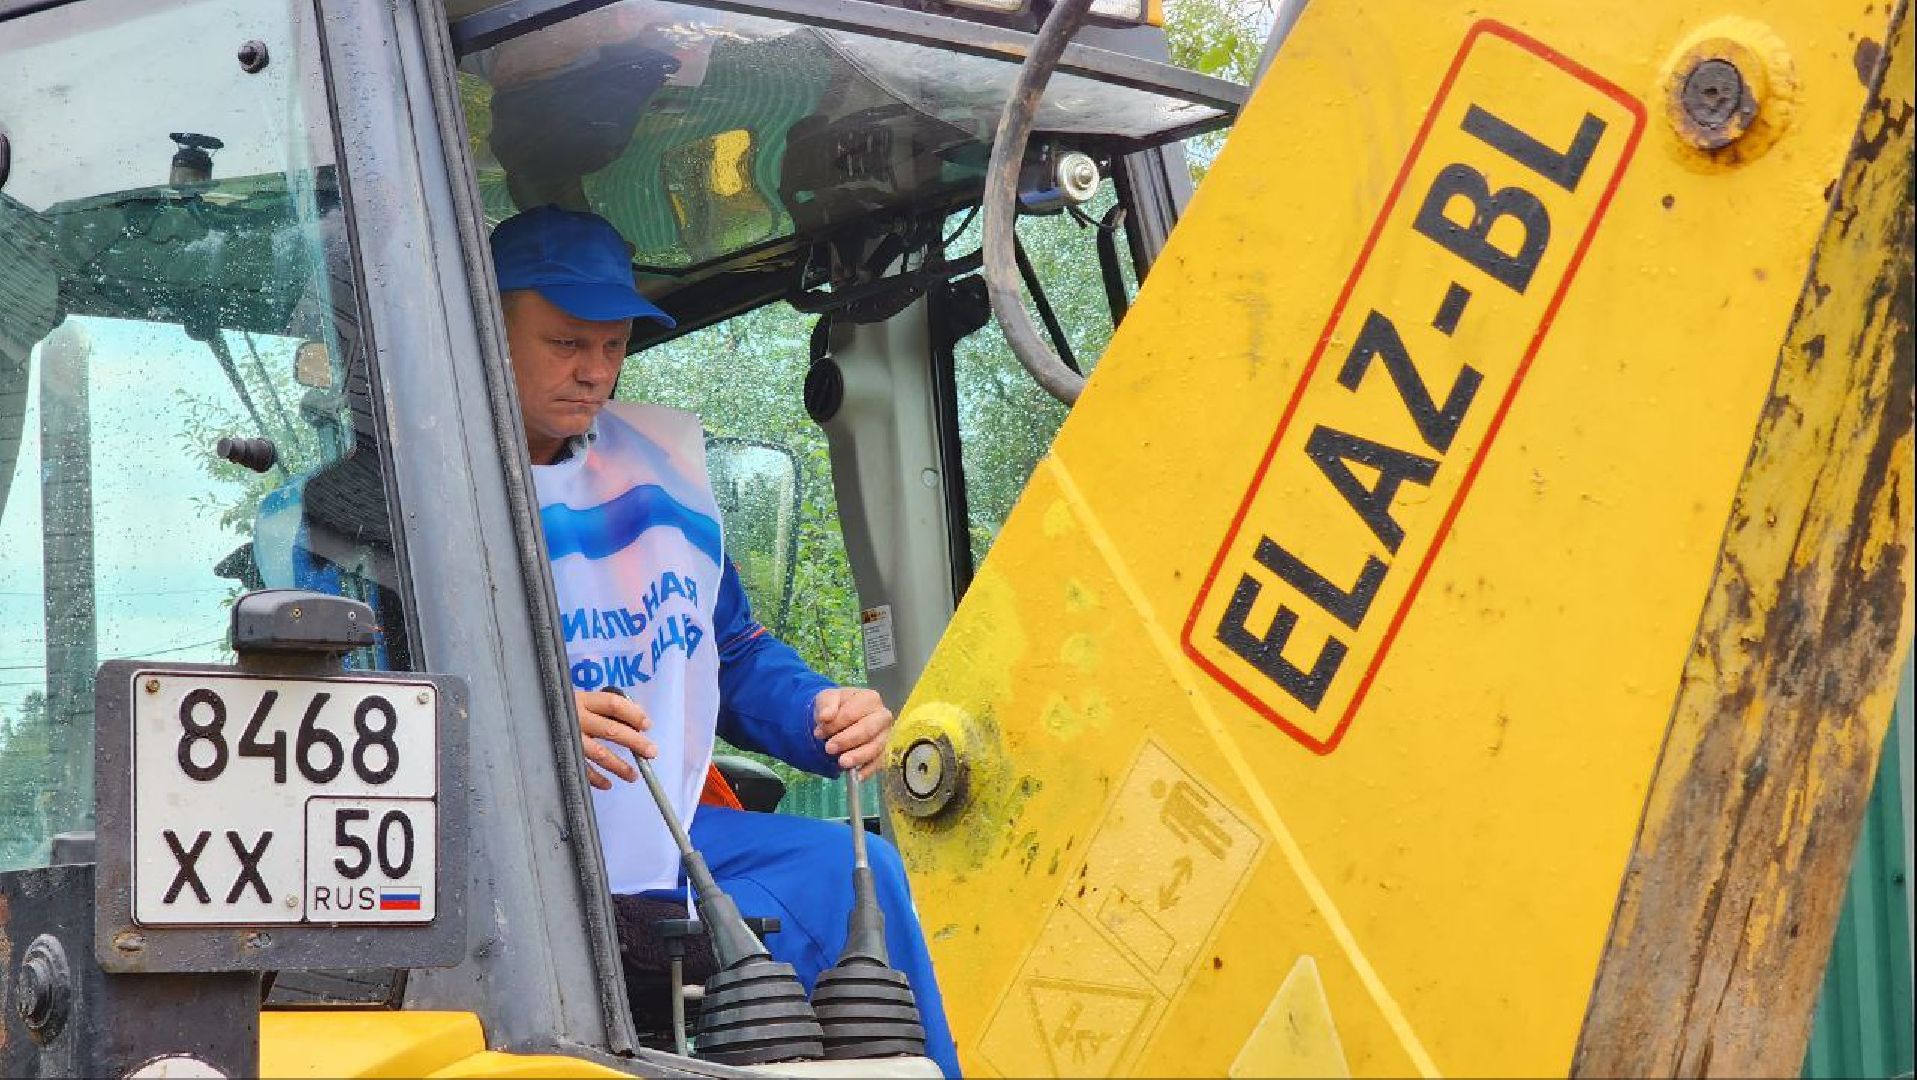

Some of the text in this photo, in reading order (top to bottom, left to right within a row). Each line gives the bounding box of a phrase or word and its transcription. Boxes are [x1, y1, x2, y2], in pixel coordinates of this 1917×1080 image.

[1216, 103, 1608, 712] ELAZ-BL
[177, 688, 400, 784] 8468
[334, 808, 414, 880] 50
[314, 886, 376, 911] RUS
